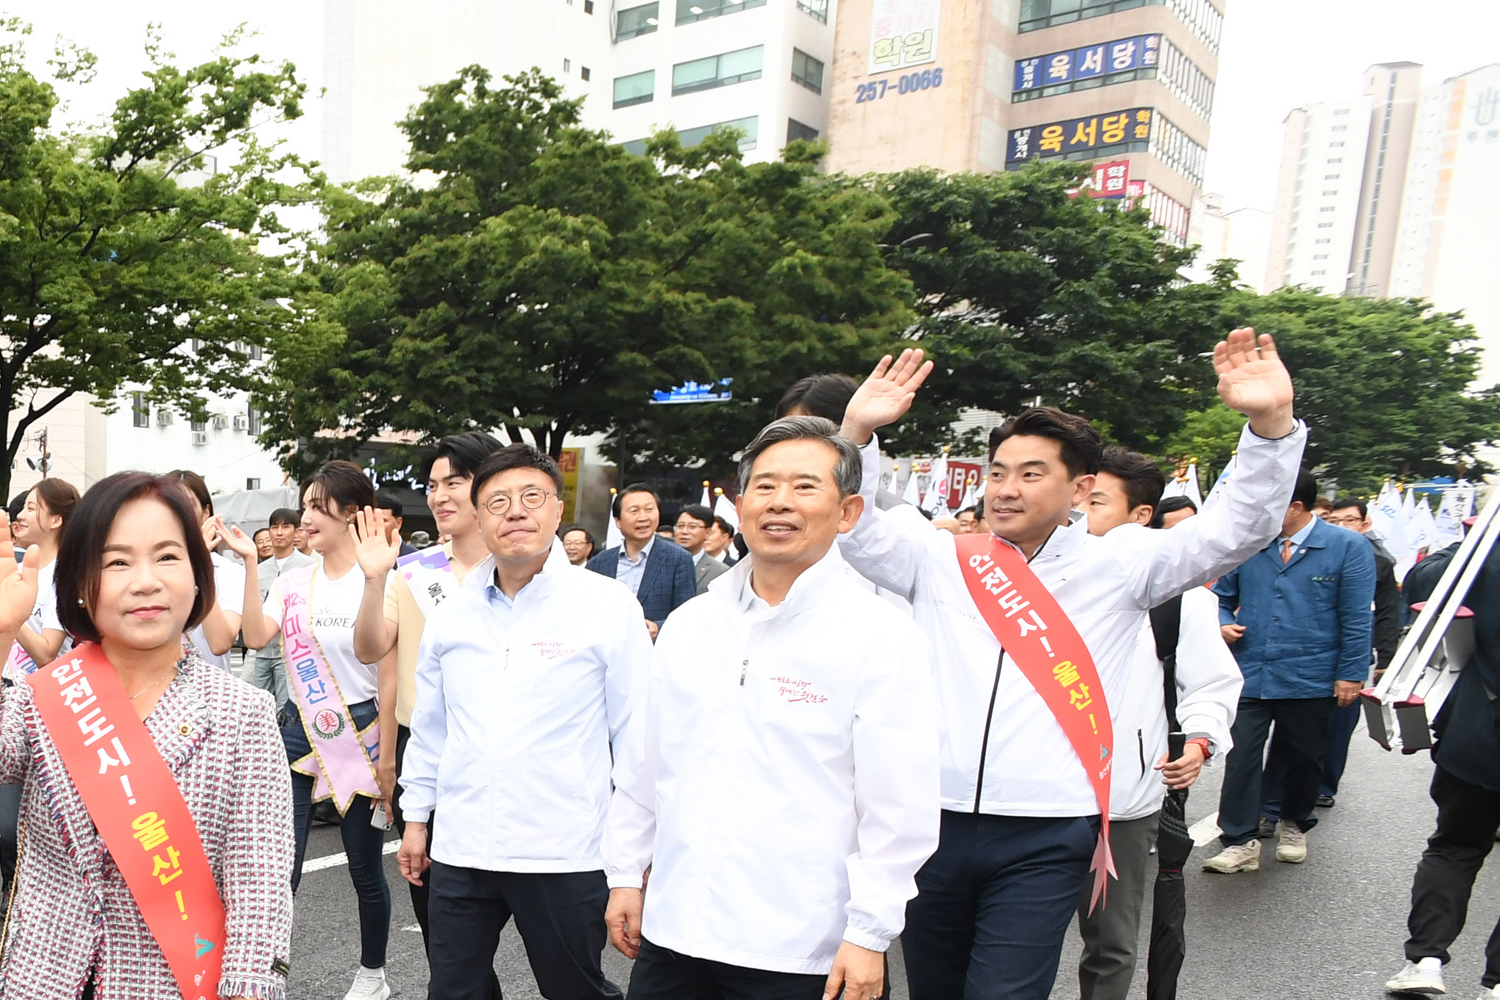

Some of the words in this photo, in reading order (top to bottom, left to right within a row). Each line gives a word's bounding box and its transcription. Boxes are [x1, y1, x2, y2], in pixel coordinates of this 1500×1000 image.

[873, 29, 933, 66] 학원
[1048, 41, 1137, 80] 육서당
[854, 67, 943, 104] 257-0066
[1038, 113, 1129, 152] 육서당
[1134, 109, 1151, 138] 학원
